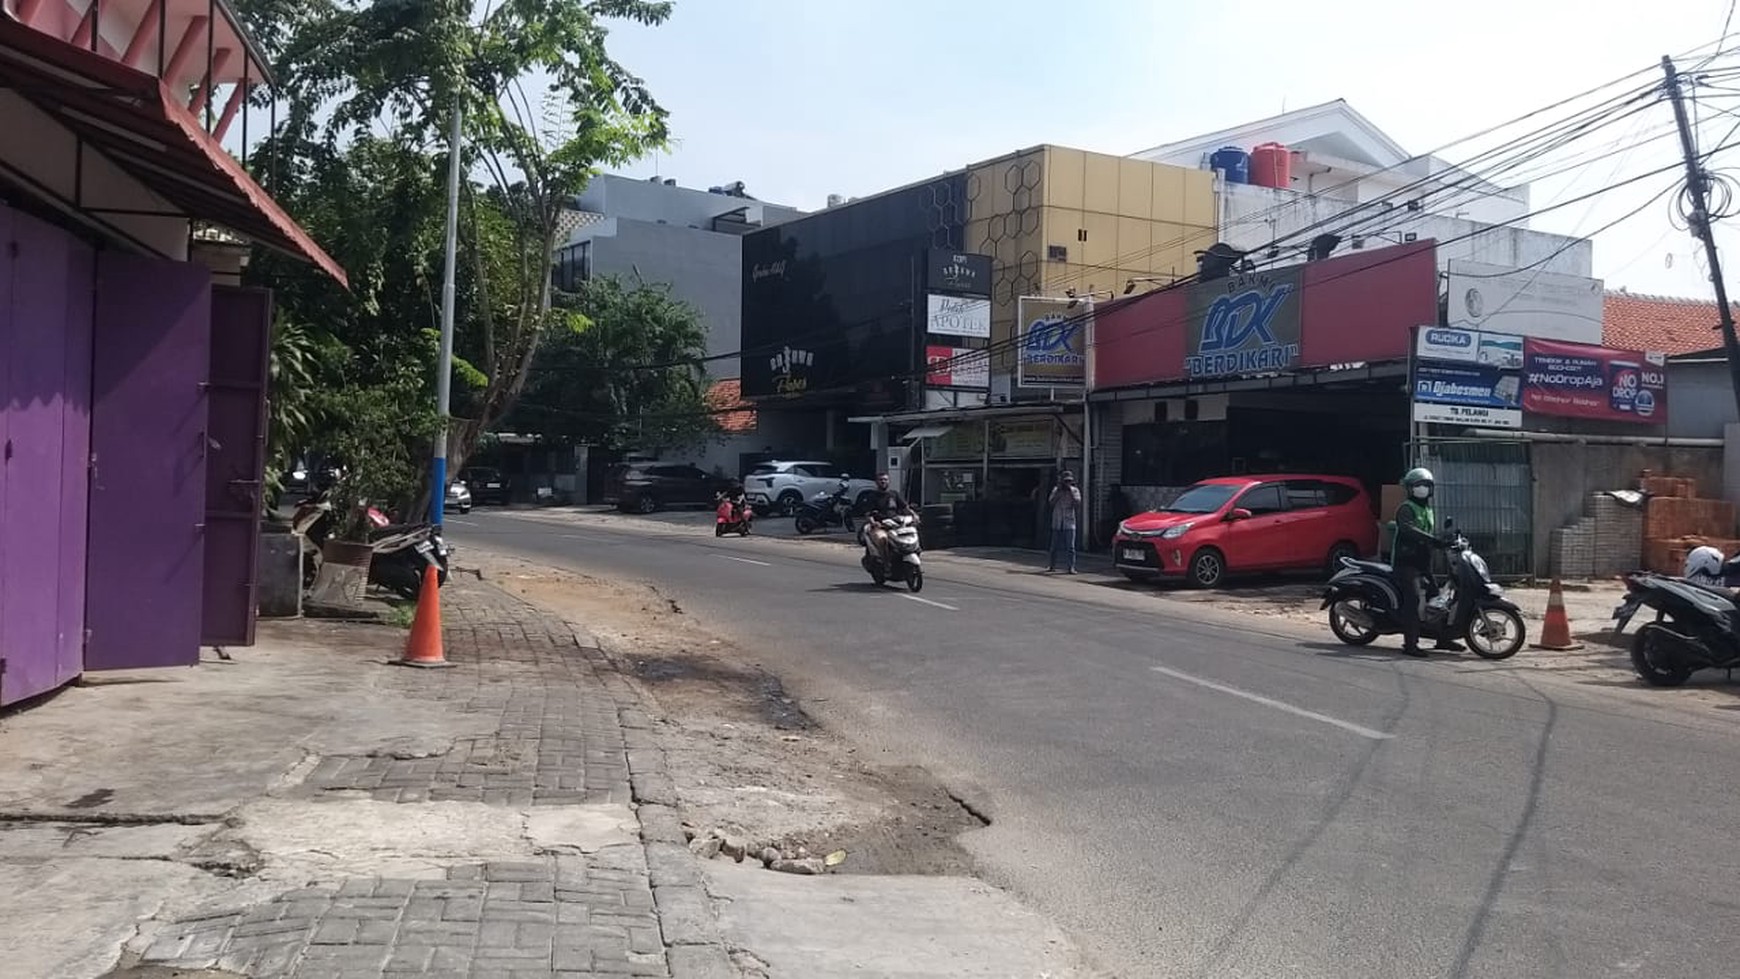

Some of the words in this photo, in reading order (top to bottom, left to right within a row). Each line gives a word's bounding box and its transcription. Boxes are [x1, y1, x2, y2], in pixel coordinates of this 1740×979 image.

[1227, 273, 1276, 293] BAKMI
[1431, 333, 1467, 345] RUCIKA
[1528, 374, 1603, 388] #NoDropAja
[1619, 374, 1637, 388] NO
[1612, 386, 1637, 399] DROP
